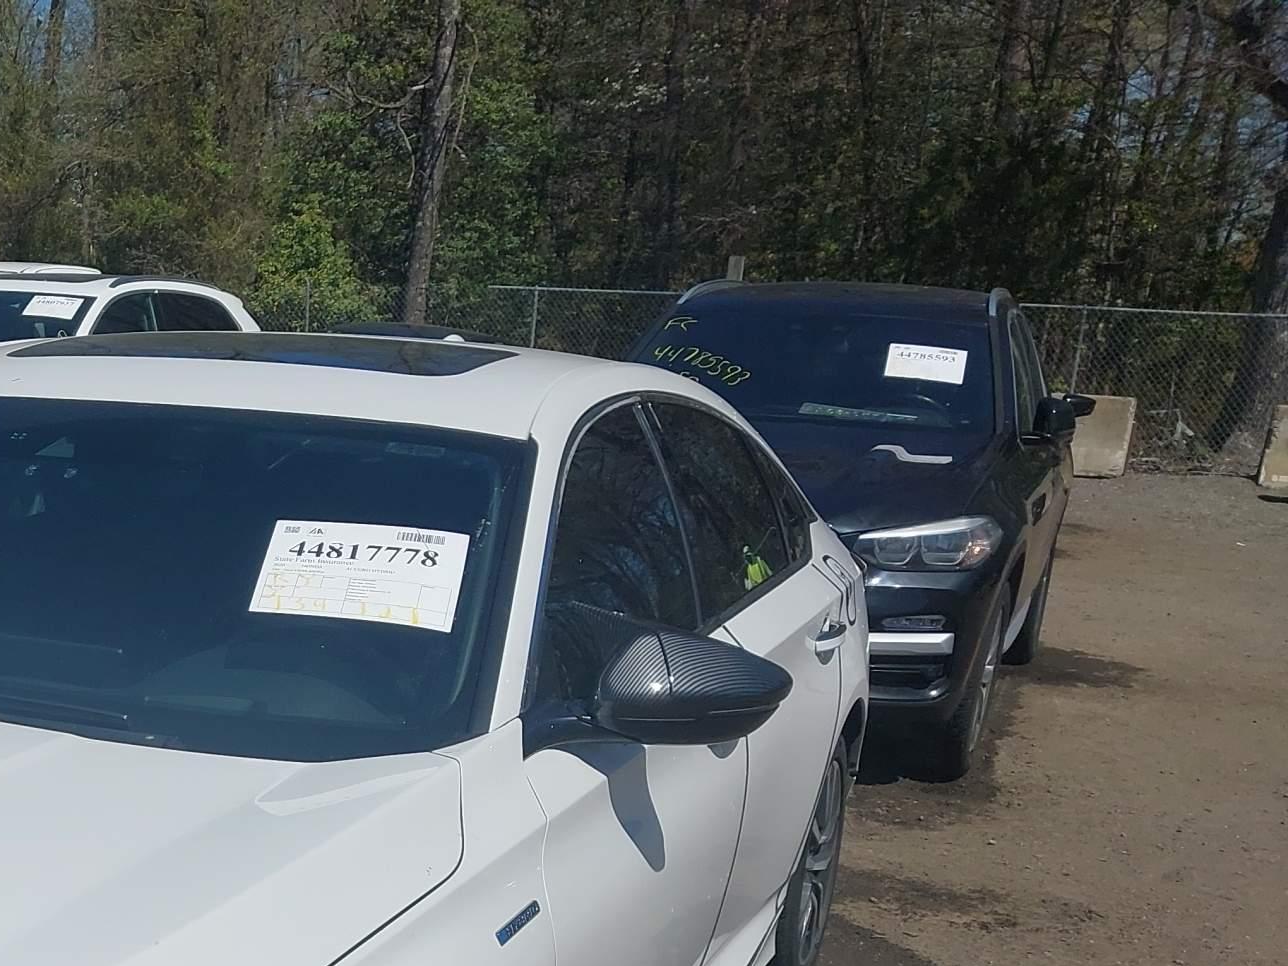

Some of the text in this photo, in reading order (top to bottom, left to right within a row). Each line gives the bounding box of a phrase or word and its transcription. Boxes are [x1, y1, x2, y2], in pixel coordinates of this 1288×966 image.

[654, 345, 751, 386] 44785593
[896, 351, 956, 363] 44785593
[288, 540, 440, 568] 44817778
